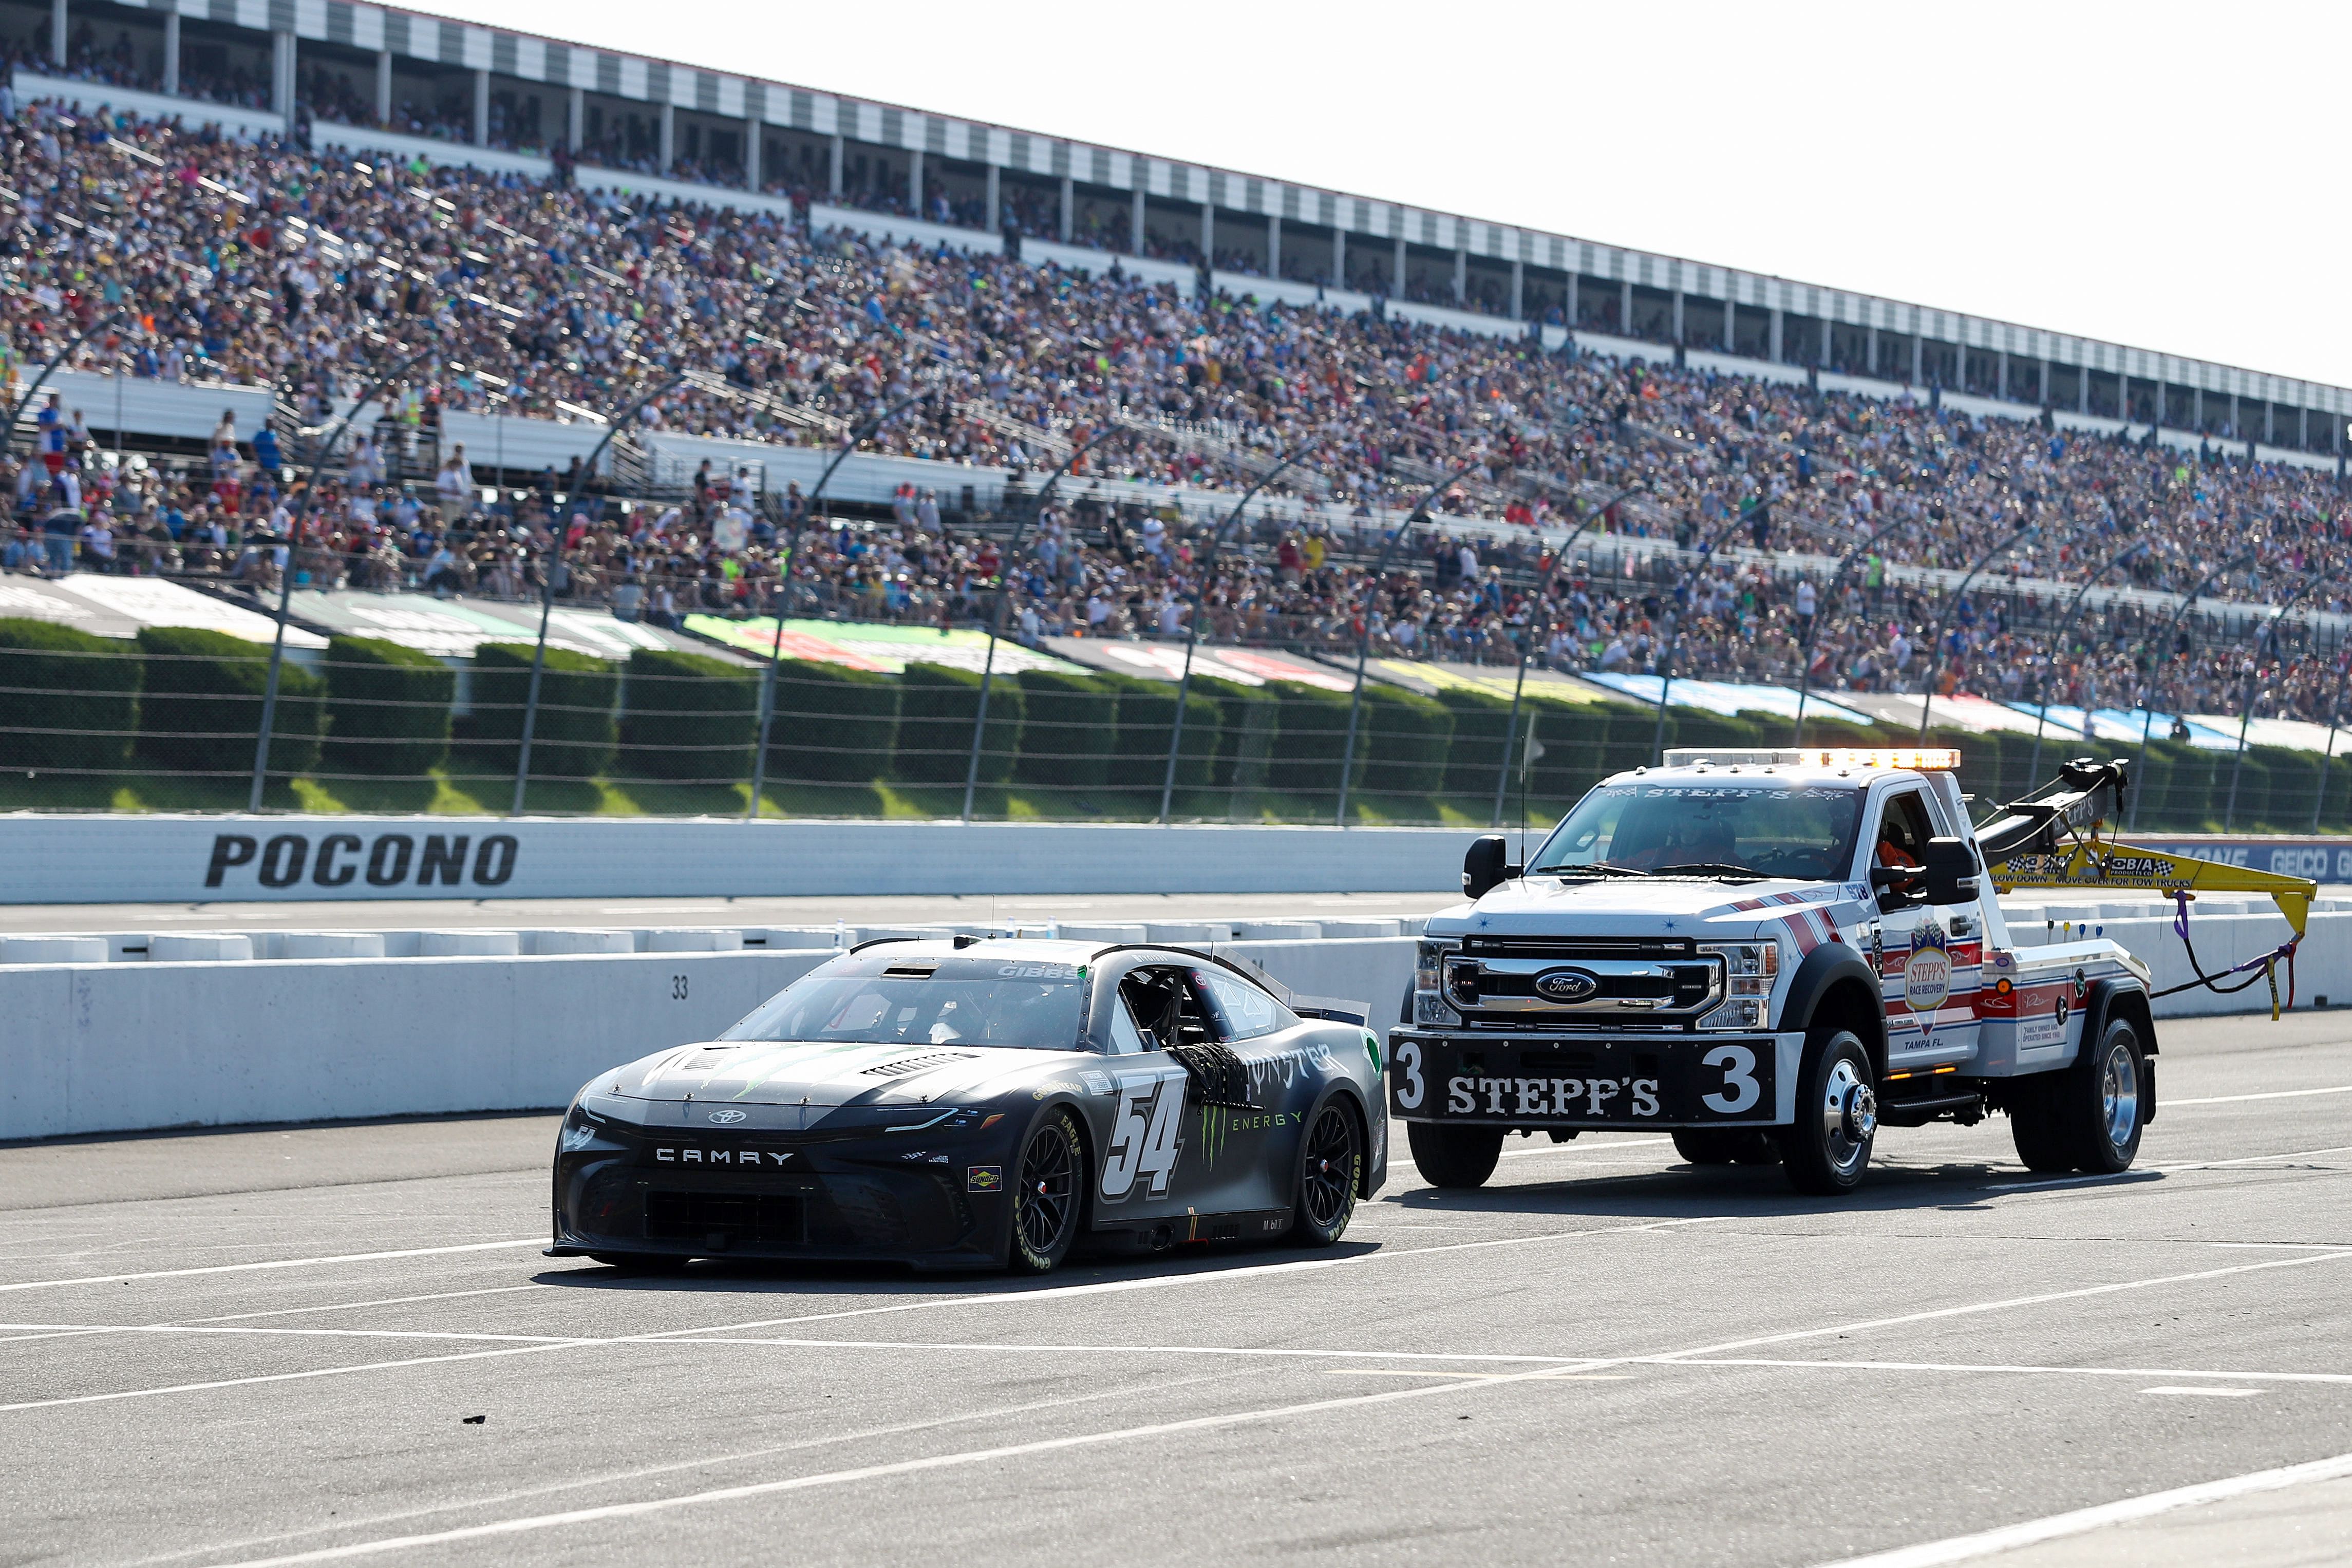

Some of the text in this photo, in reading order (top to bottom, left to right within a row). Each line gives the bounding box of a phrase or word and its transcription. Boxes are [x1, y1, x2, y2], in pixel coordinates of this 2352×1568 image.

[1645, 788, 1792, 800] STEPP'S
[2054, 796, 2093, 830] SEPP'S
[204, 834, 519, 887] POCONO
[2127, 858, 2153, 871] B/A
[2271, 848, 2328, 878] GEICO
[2017, 875, 2048, 883] DOWN
[2155, 879, 2191, 887] TRUCKS
[998, 965, 1079, 980] GIBBS
[1910, 961, 1946, 983] STEPP'S
[672, 975, 688, 1000] 33
[1549, 977, 1582, 992] Ford
[1909, 983, 1946, 995] RACE RECOVERY
[1905, 1038, 1944, 1050] TAMPA FL.
[1239, 1044, 1350, 1095] ONSTER
[1396, 1041, 1425, 1109] 3
[1701, 1045, 1761, 1114] 3
[1032, 1080, 1084, 1101] GOODYEAR
[1448, 1076, 1661, 1117] STEPP'S
[1233, 1111, 1303, 1131] ENERGY
[1060, 1114, 1081, 1157] EAGLE
[1100, 1067, 1190, 1201] 54
[656, 1148, 794, 1165] CAMRY
[970, 1175, 999, 1184] SUNOCO
[1328, 1154, 1361, 1241] GOODYEAR
